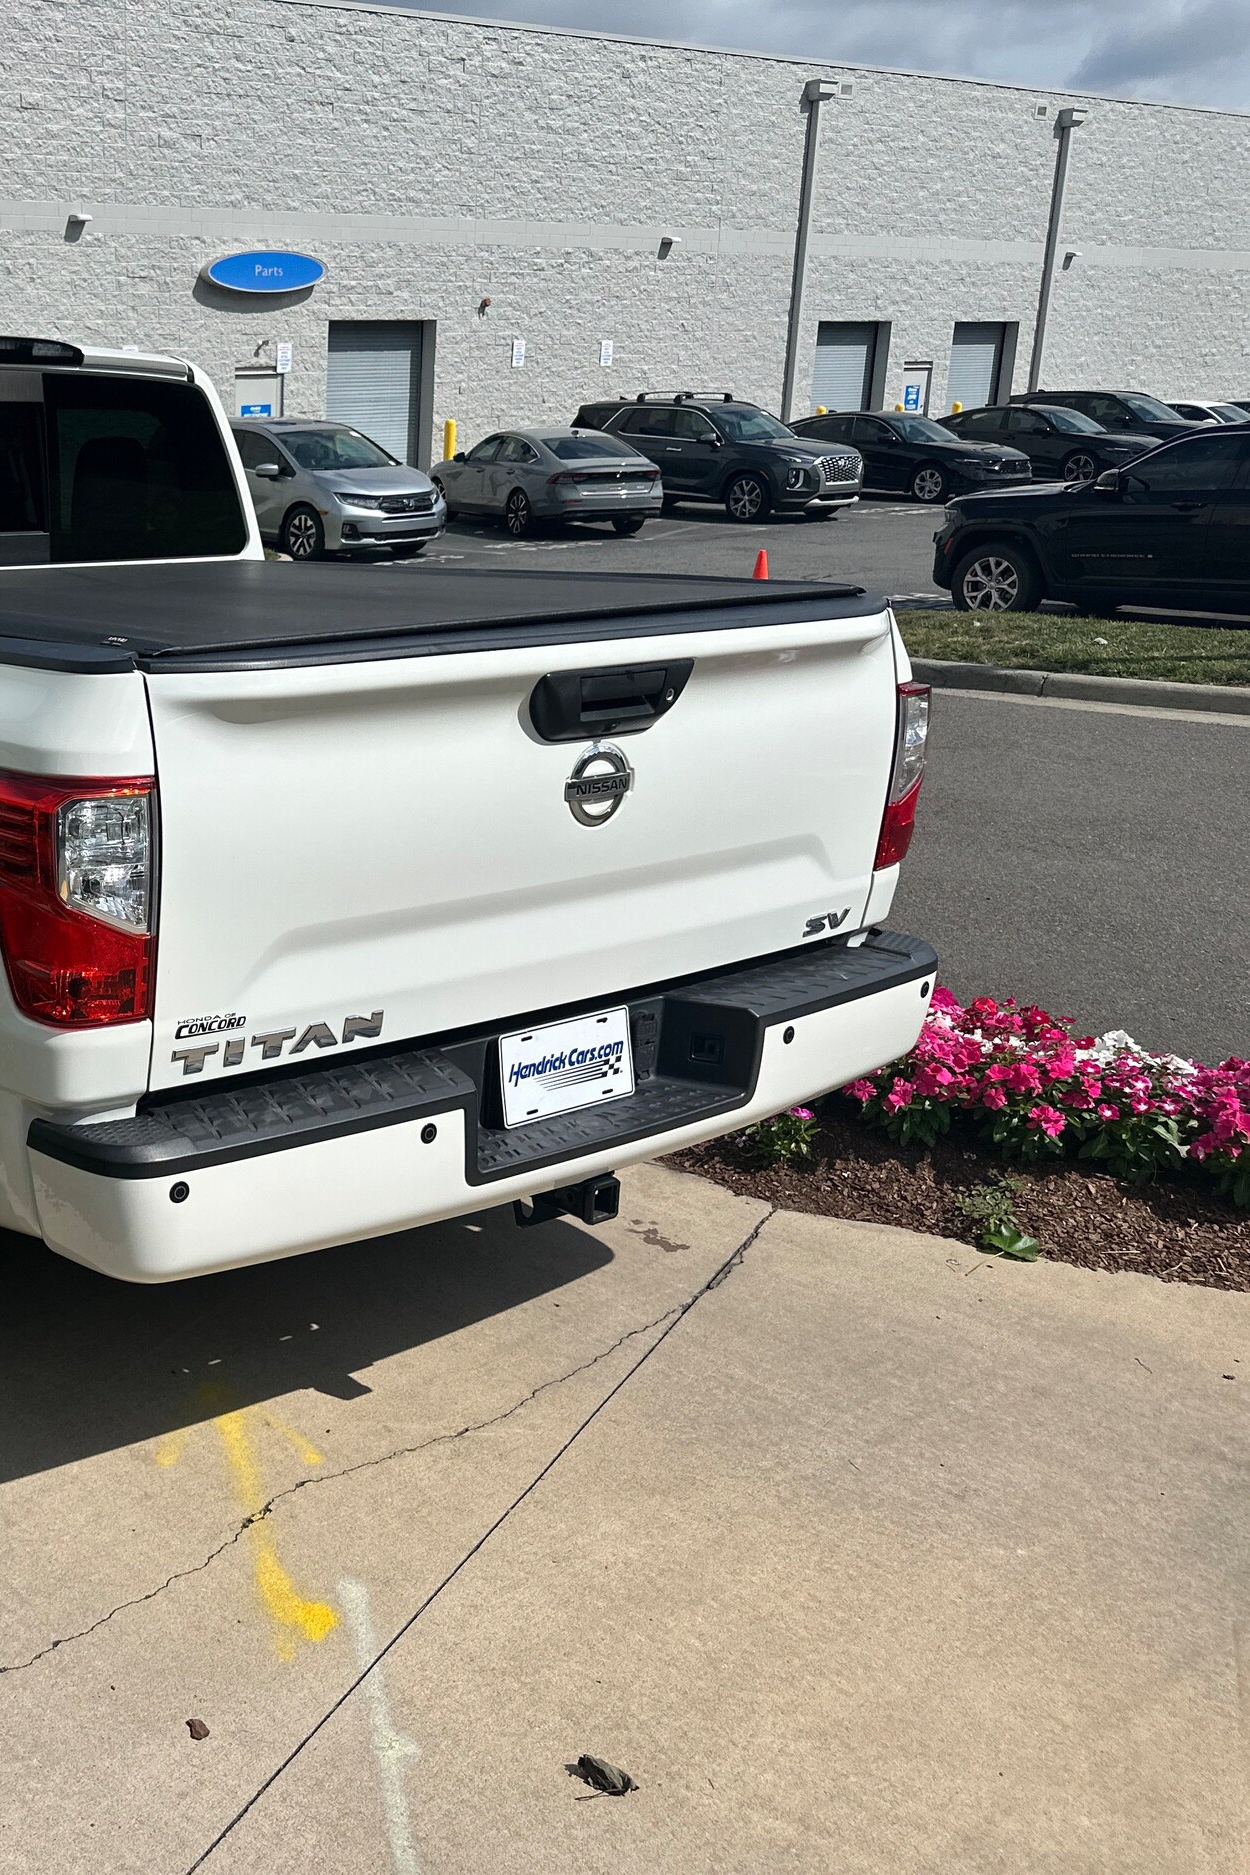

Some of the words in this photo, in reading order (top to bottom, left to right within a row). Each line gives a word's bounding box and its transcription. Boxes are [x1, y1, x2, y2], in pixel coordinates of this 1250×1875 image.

[255, 264, 283, 277] Parts
[575, 777, 627, 796] NISSAN
[802, 907, 851, 938] SV
[175, 1015, 247, 1039] CONCORD
[177, 1014, 222, 1025] HONDA
[171, 1009, 384, 1076] TITAN
